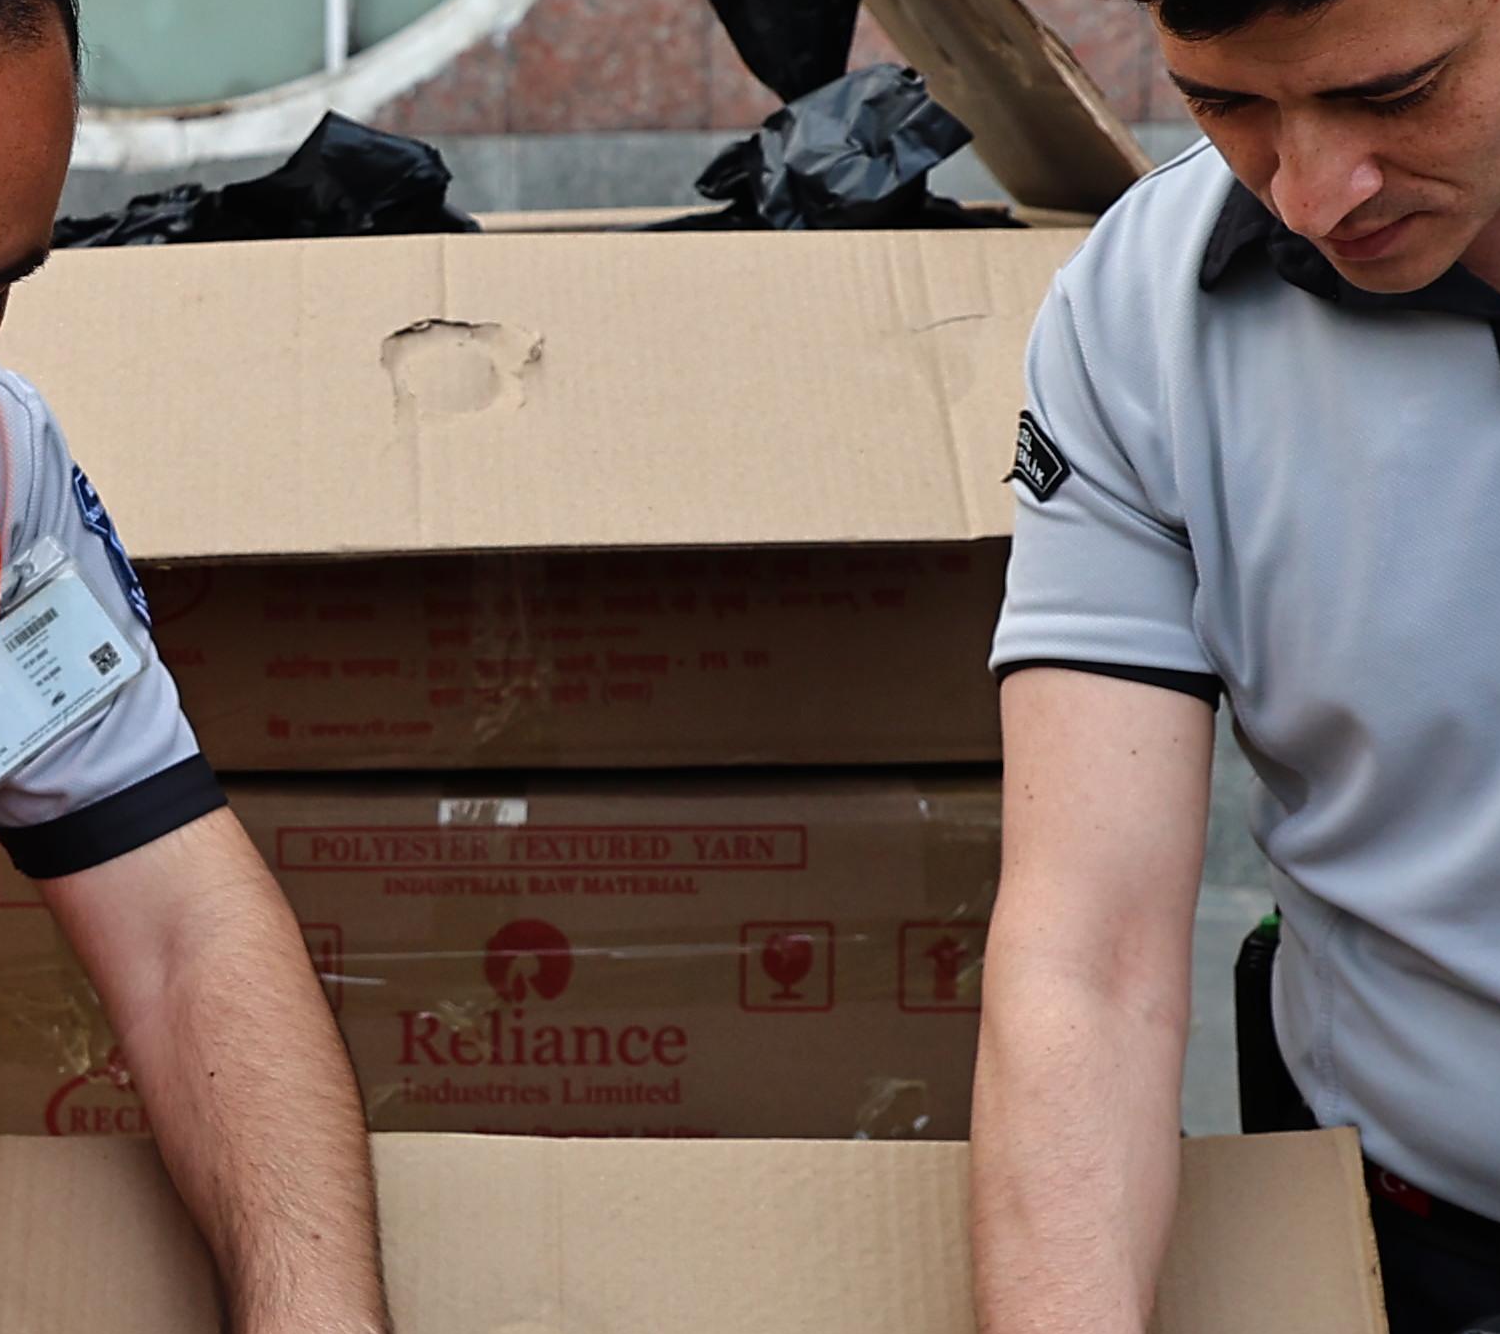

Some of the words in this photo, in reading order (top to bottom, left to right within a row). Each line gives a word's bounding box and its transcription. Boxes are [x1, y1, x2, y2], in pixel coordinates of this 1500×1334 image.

[309, 835, 490, 863] POLYESTER
[509, 833, 673, 862] TEXTURED
[693, 833, 778, 861] YARN
[382, 878, 522, 896] INDUSTRIAL
[527, 877, 582, 895] RAW
[582, 876, 699, 895] MATERIAL
[397, 1007, 690, 1067] Reliance
[561, 1078, 683, 1106] Limited
